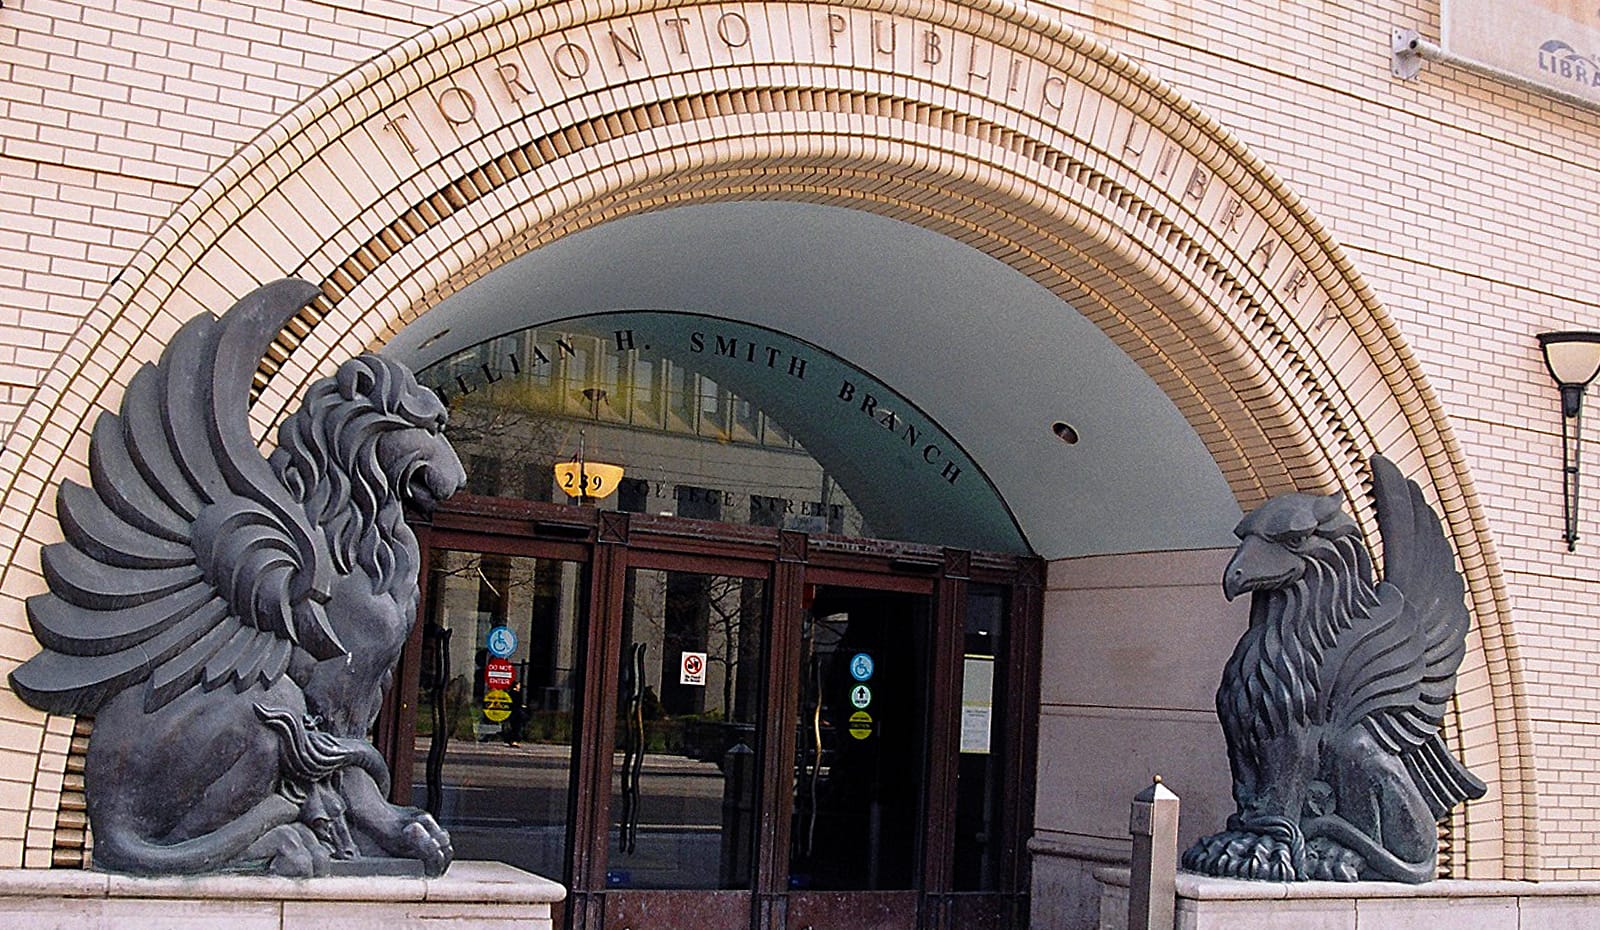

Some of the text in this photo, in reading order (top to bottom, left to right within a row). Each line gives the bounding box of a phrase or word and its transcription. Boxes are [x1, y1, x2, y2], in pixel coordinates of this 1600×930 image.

[383, 12, 1342, 331] TORONTO PUBLIC LIBRARY
[434, 329, 963, 485] ILLIAN H. SMITH BRANCH
[751, 493, 844, 519] STREET
[499, 664, 512, 672] NOT
